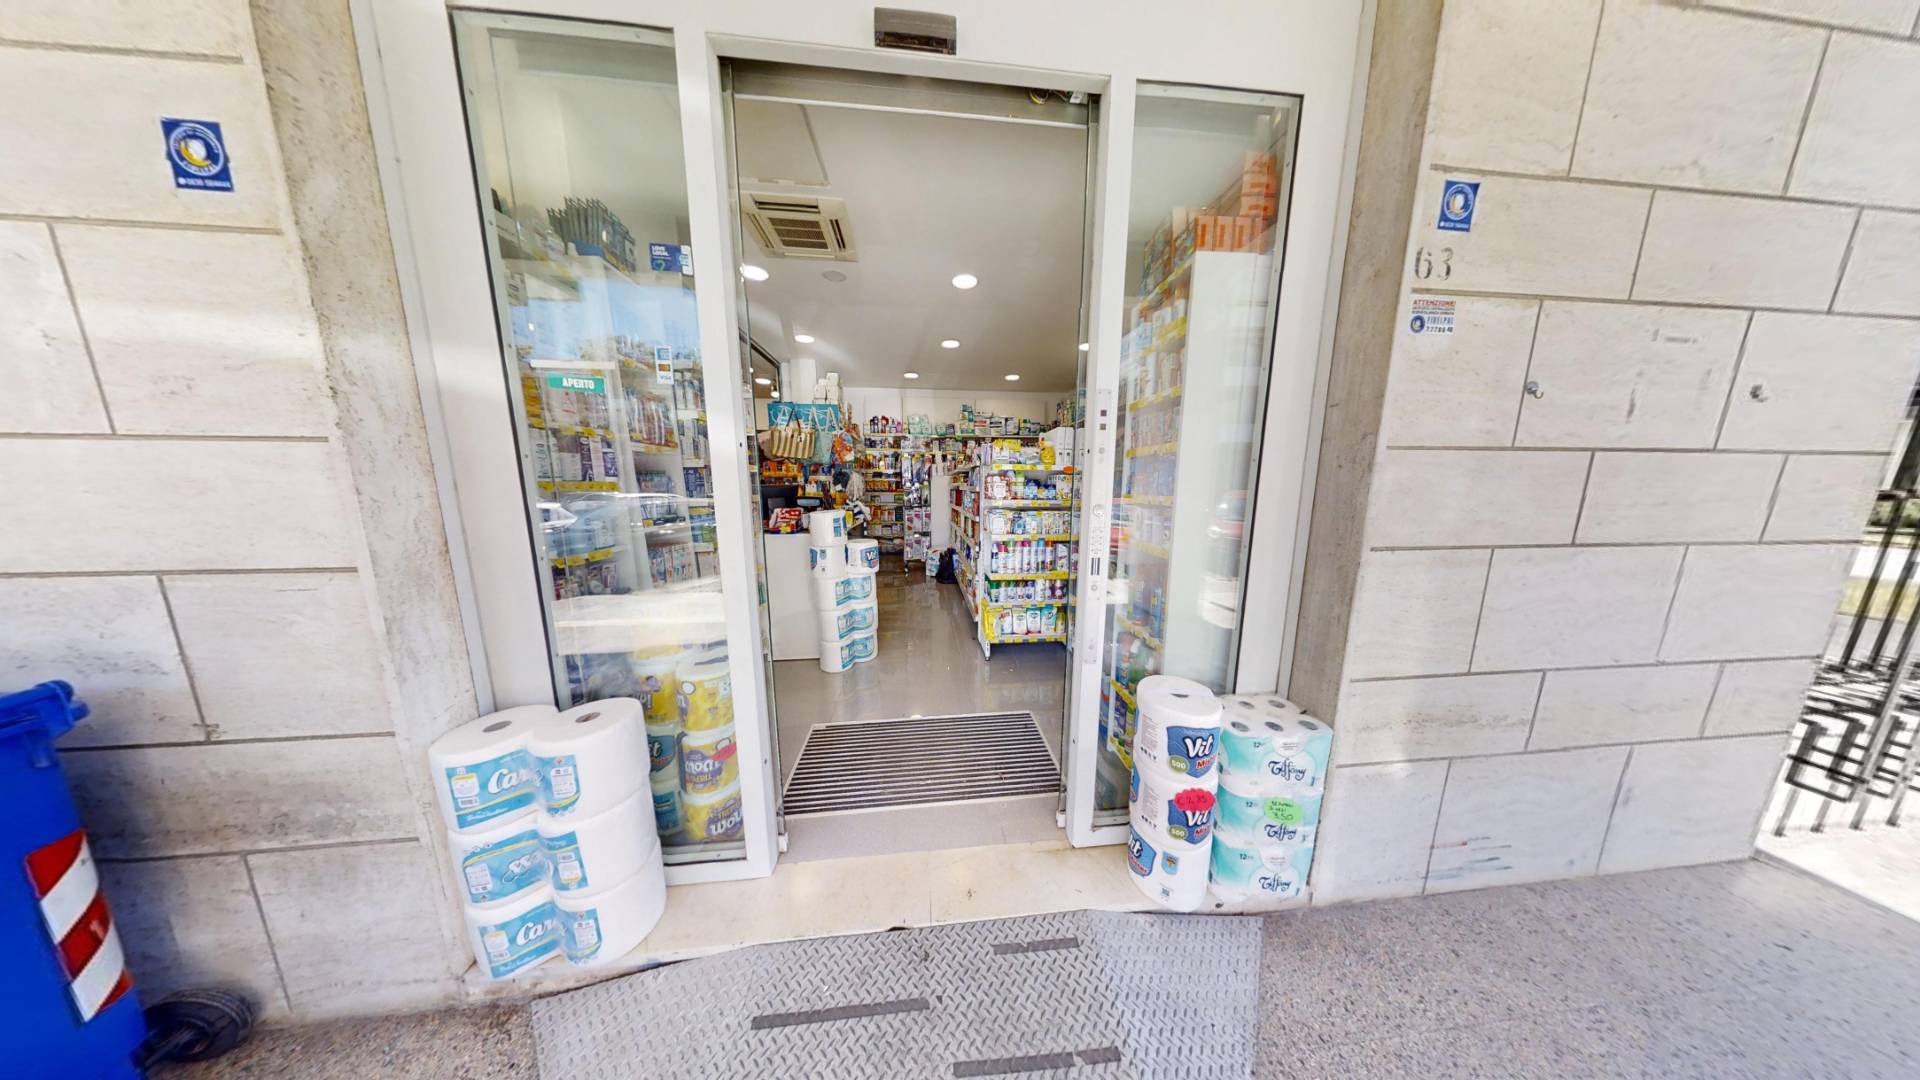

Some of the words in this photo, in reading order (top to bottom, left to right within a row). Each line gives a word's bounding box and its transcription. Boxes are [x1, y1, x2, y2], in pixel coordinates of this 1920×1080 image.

[1414, 247, 1454, 281] 63
[562, 377, 595, 390] APERTO
[1183, 734, 1214, 758] Vit
[1268, 757, 1306, 781] Tiffany
[1258, 872, 1292, 892] Tiffany
